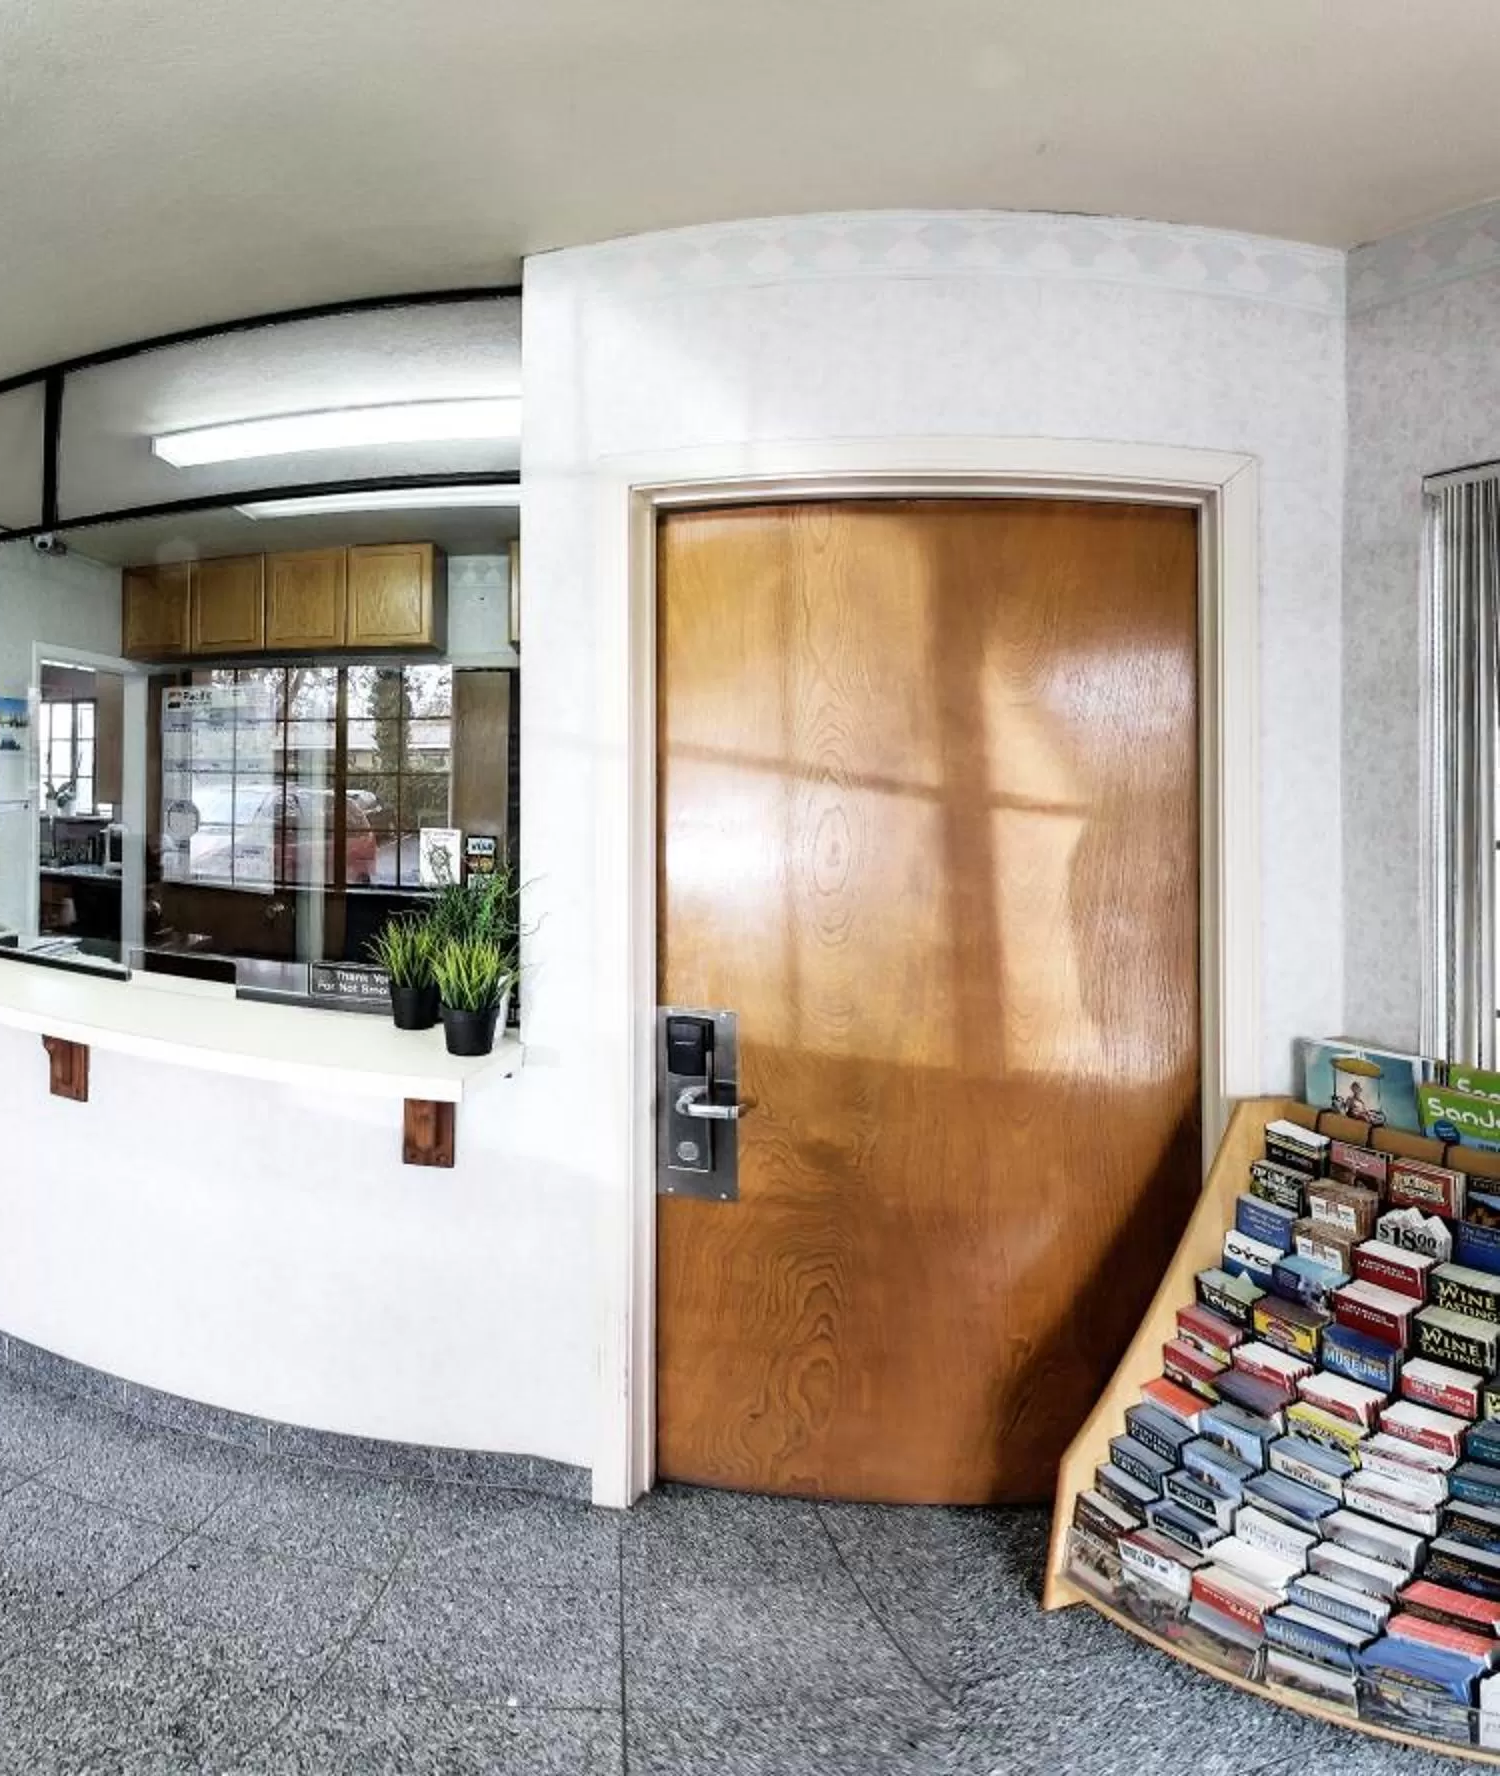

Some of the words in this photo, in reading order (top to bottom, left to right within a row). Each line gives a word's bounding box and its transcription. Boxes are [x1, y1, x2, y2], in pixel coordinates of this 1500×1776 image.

[337, 970, 368, 983] Thank
[339, 982, 358, 993] Not
[1437, 1297, 1498, 1323] TASTING
[1438, 1281, 1496, 1311] WINE
[1422, 1325, 1479, 1354] WINE
[1325, 1349, 1387, 1382] MUSEUMS
[1420, 1340, 1482, 1368] TASTING
